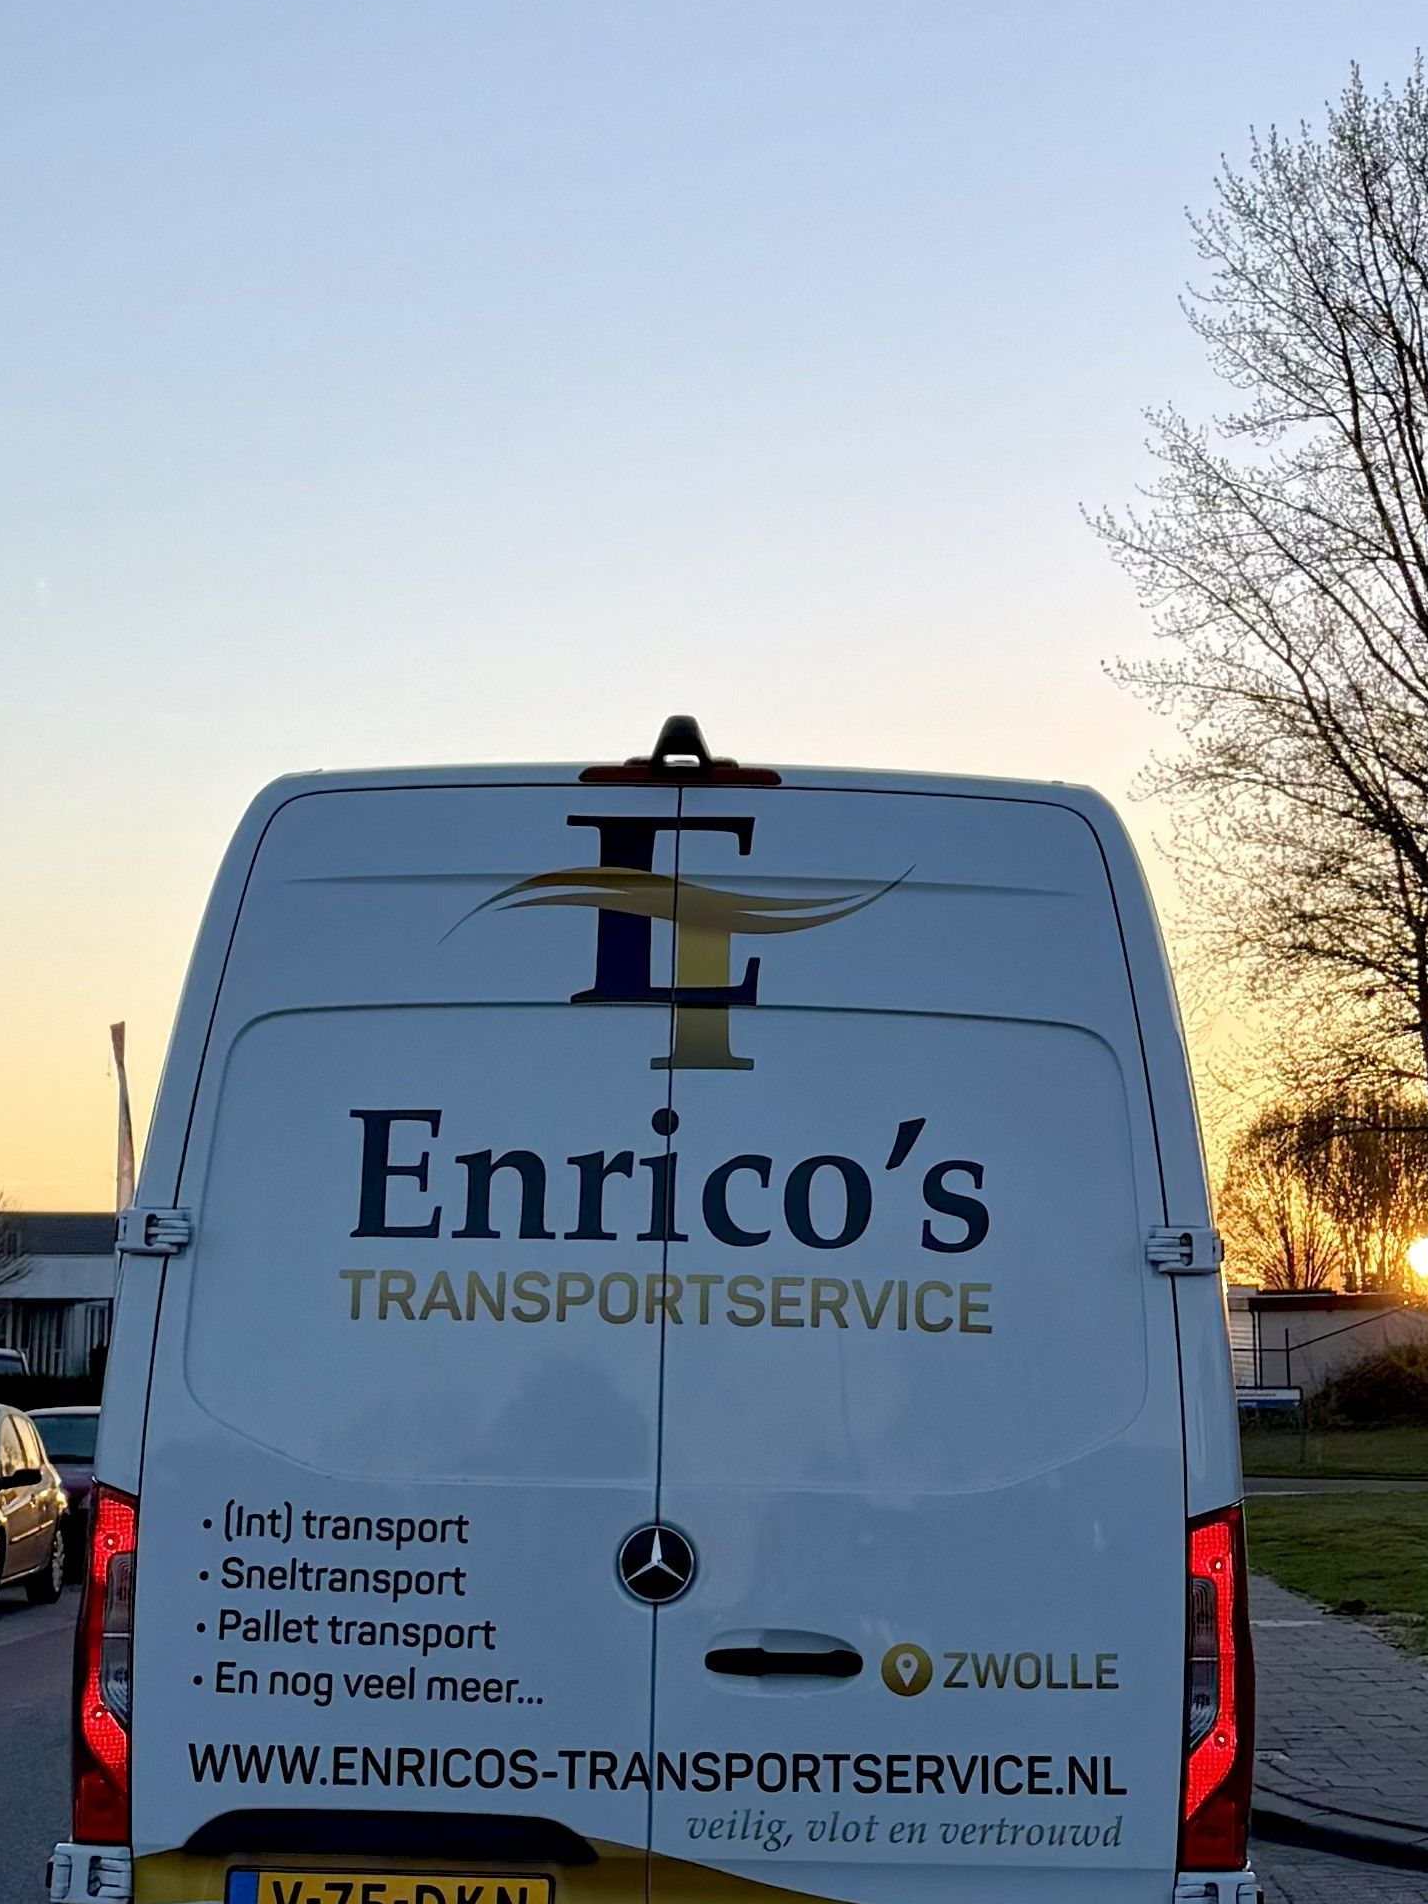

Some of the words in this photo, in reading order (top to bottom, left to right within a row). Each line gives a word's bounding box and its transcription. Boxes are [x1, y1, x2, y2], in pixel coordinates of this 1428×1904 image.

[338, 1269, 994, 1335] TRANSPORTSERVICE
[223, 1498, 293, 1545] (Int)
[301, 1509, 470, 1551] transport
[221, 1556, 467, 1604] Sneltransport
[218, 1608, 320, 1643] Pallet
[327, 1614, 497, 1657] transport
[215, 1661, 258, 1695] En
[269, 1670, 333, 1707] nog
[343, 1666, 416, 1701] veel
[425, 1675, 544, 1706] meer...
[942, 1651, 1120, 1691] ZWOLLE
[187, 1742, 1129, 1797] WWW.ENRICOS-TRANSPORTSERVICE.NL
[686, 1808, 794, 1853] veilig,
[806, 1810, 877, 1844] vlot
[888, 1819, 927, 1845] en
[938, 1815, 1124, 1848] vertrouwd
